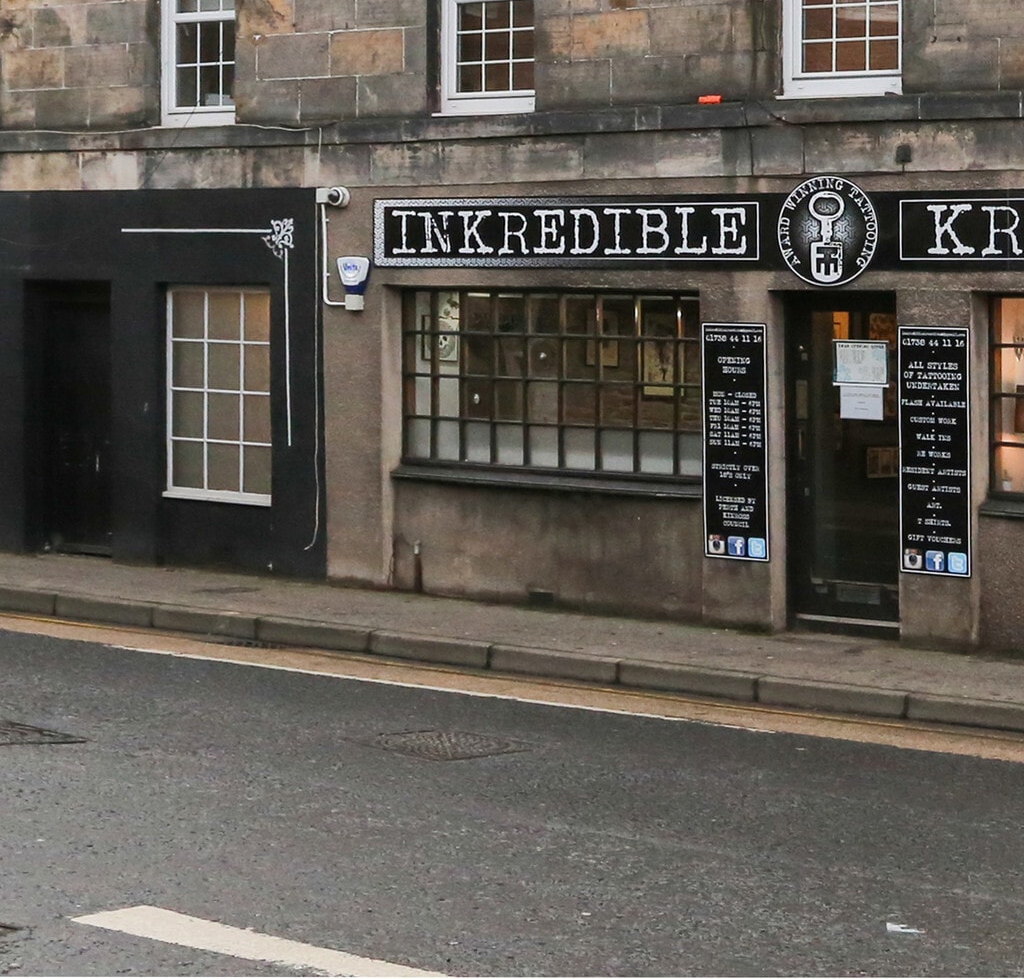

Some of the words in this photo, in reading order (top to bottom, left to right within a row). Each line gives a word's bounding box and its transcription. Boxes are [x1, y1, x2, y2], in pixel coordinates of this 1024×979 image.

[785, 179, 843, 211] WINNING
[391, 206, 747, 256] INKREDIBLE
[847, 187, 877, 267] TATTOOING
[780, 217, 801, 266] AWARD
[942, 339, 952, 347] 11
[717, 356, 751, 364] OPENING
[908, 361, 924, 369] ALL
[926, 362, 958, 370] STYLES
[903, 371, 914, 379] OF
[917, 371, 962, 380] TATTOOING
[906, 382, 960, 390] UNDERTAKEN
[901, 398, 923, 406] FLASH
[926, 400, 966, 408] AVAILABLE
[916, 433, 936, 441] WALK
